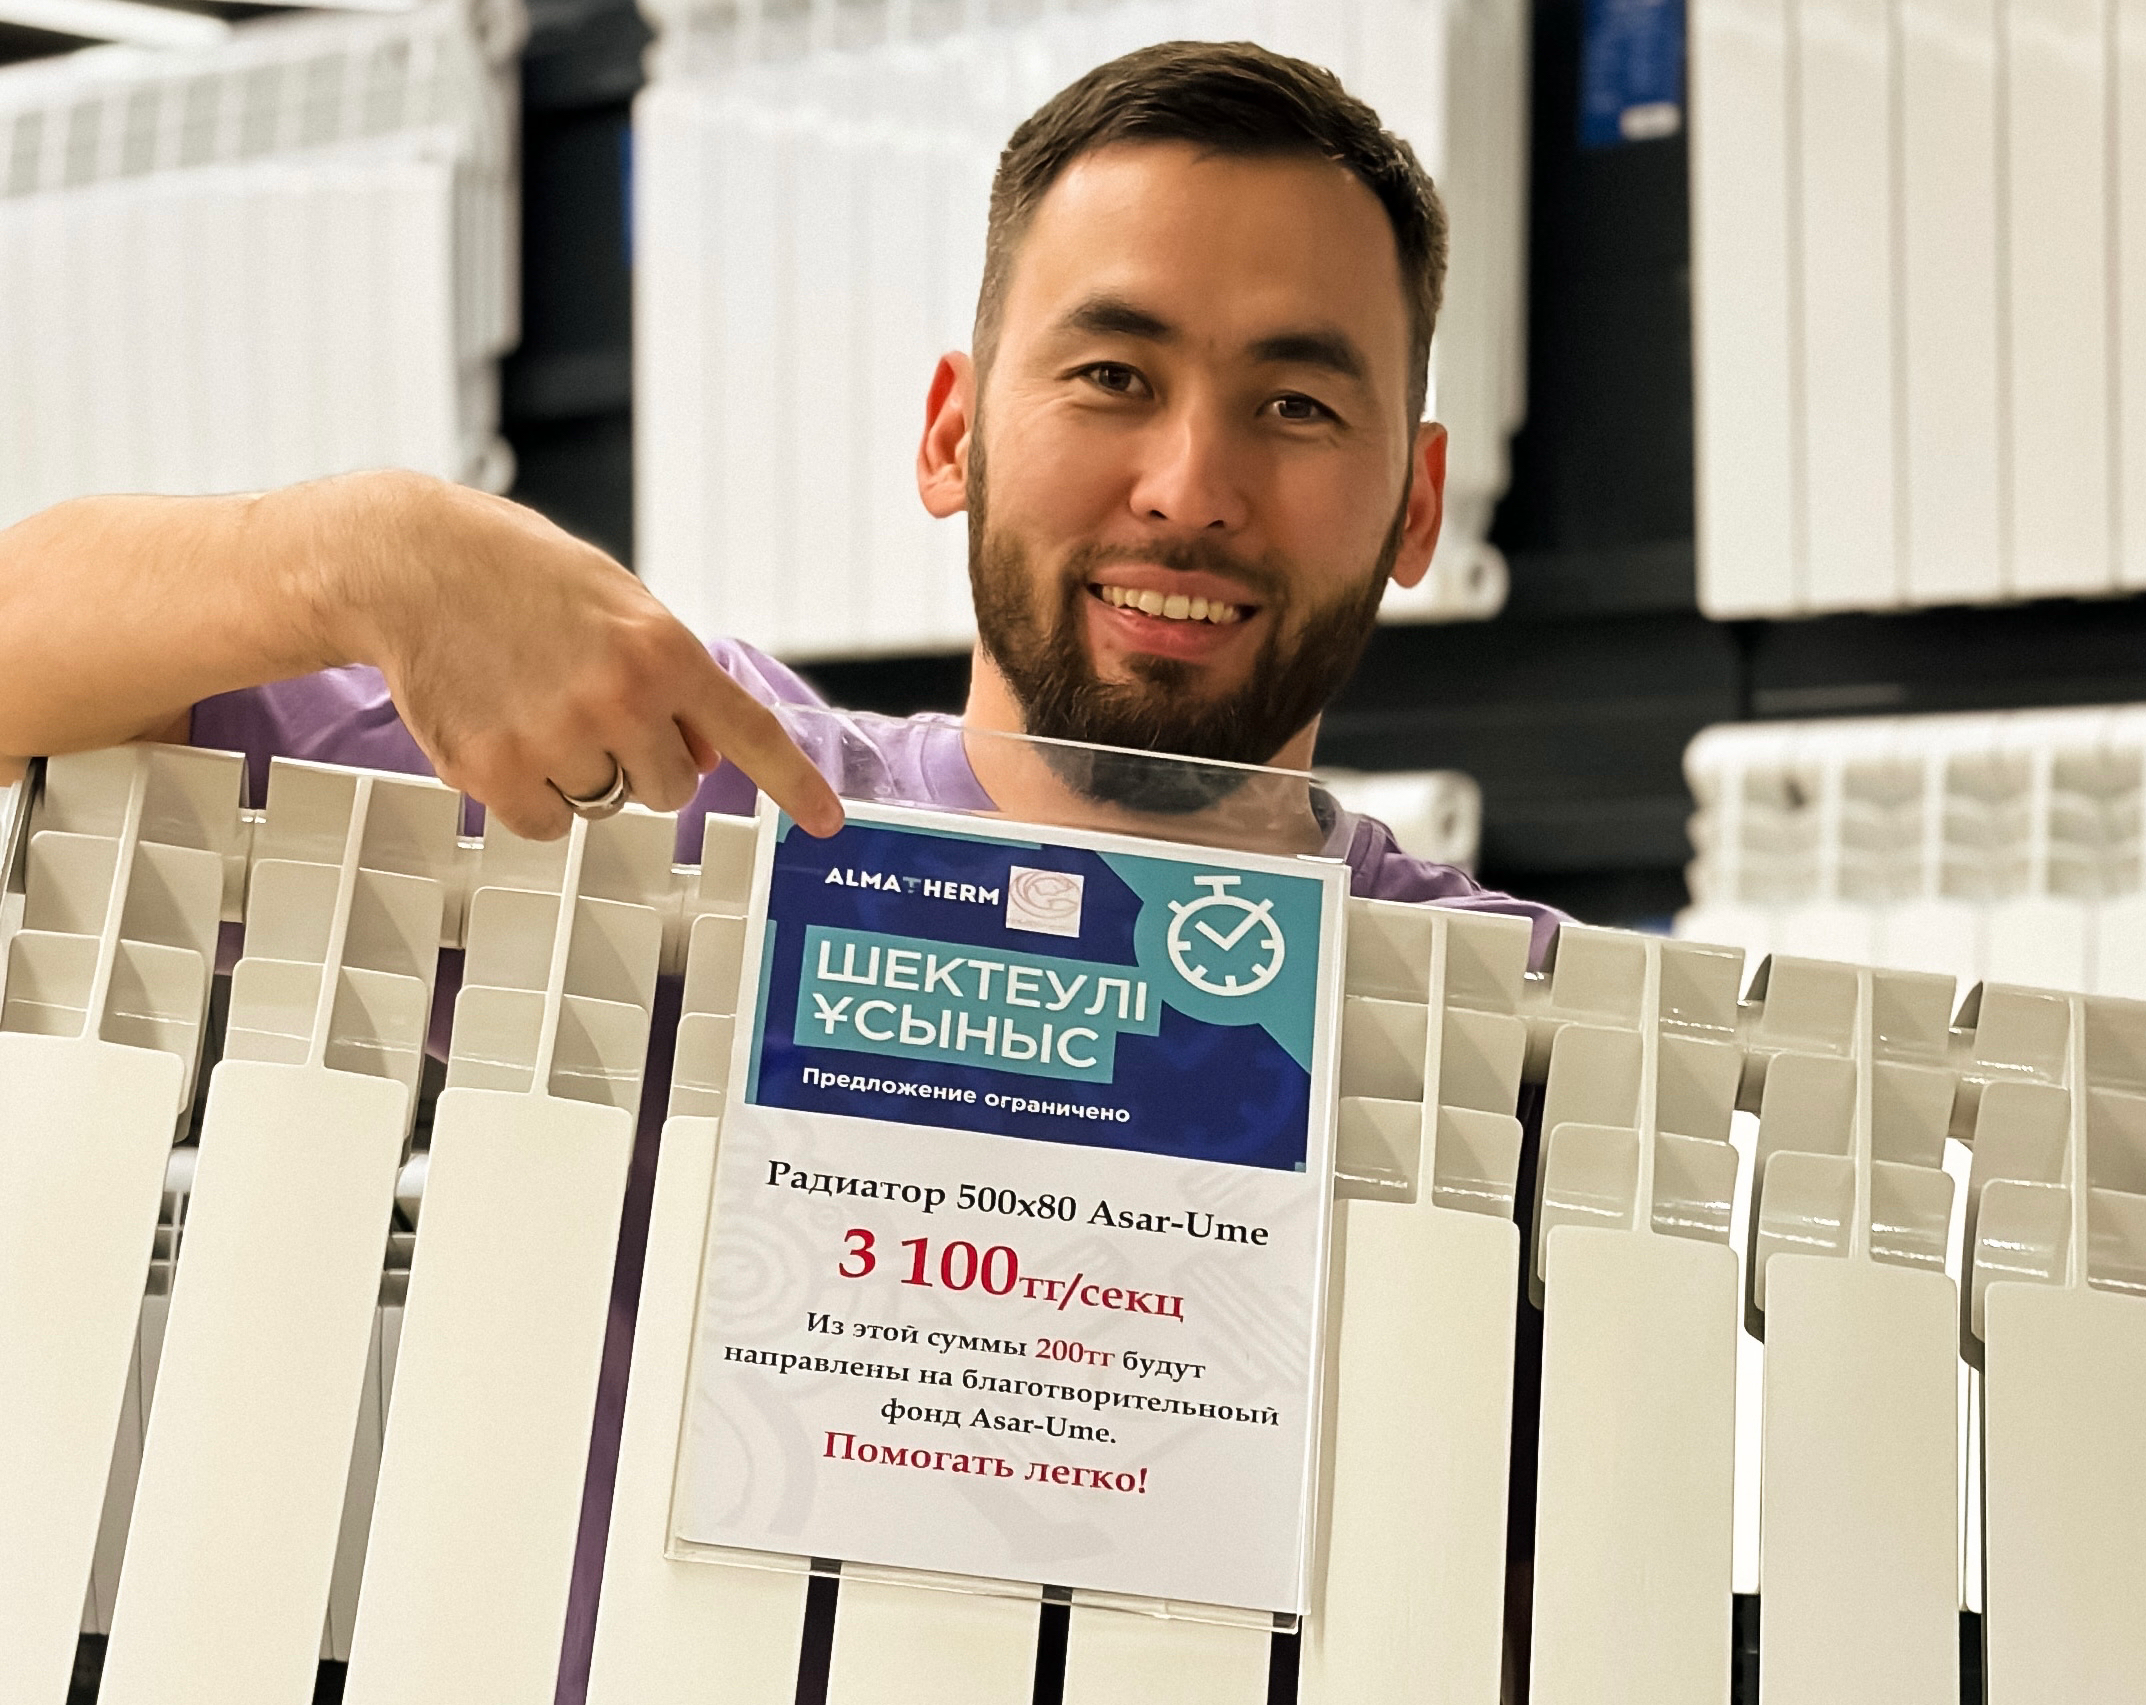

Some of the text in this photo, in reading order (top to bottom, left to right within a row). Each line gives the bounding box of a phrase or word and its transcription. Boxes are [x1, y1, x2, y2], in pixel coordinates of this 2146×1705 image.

[817, 940, 1147, 1022] ШЕКТЕУЛІ
[812, 992, 1099, 1068] ҰСЫНЫС
[802, 1067, 1130, 1123] Предложение ограничено
[766, 1160, 1269, 1246] Радиатор 500x80 Asar-Ume
[837, 1227, 1183, 1323] 3 100тг/секц
[807, 1312, 1206, 1383] Из этой суммы 200тг будут
[724, 1346, 1279, 1426] направлены на благотворительноый
[881, 1397, 1116, 1444] фонд Asar-Ume.
[822, 1431, 1149, 1494] Помогать легко!
